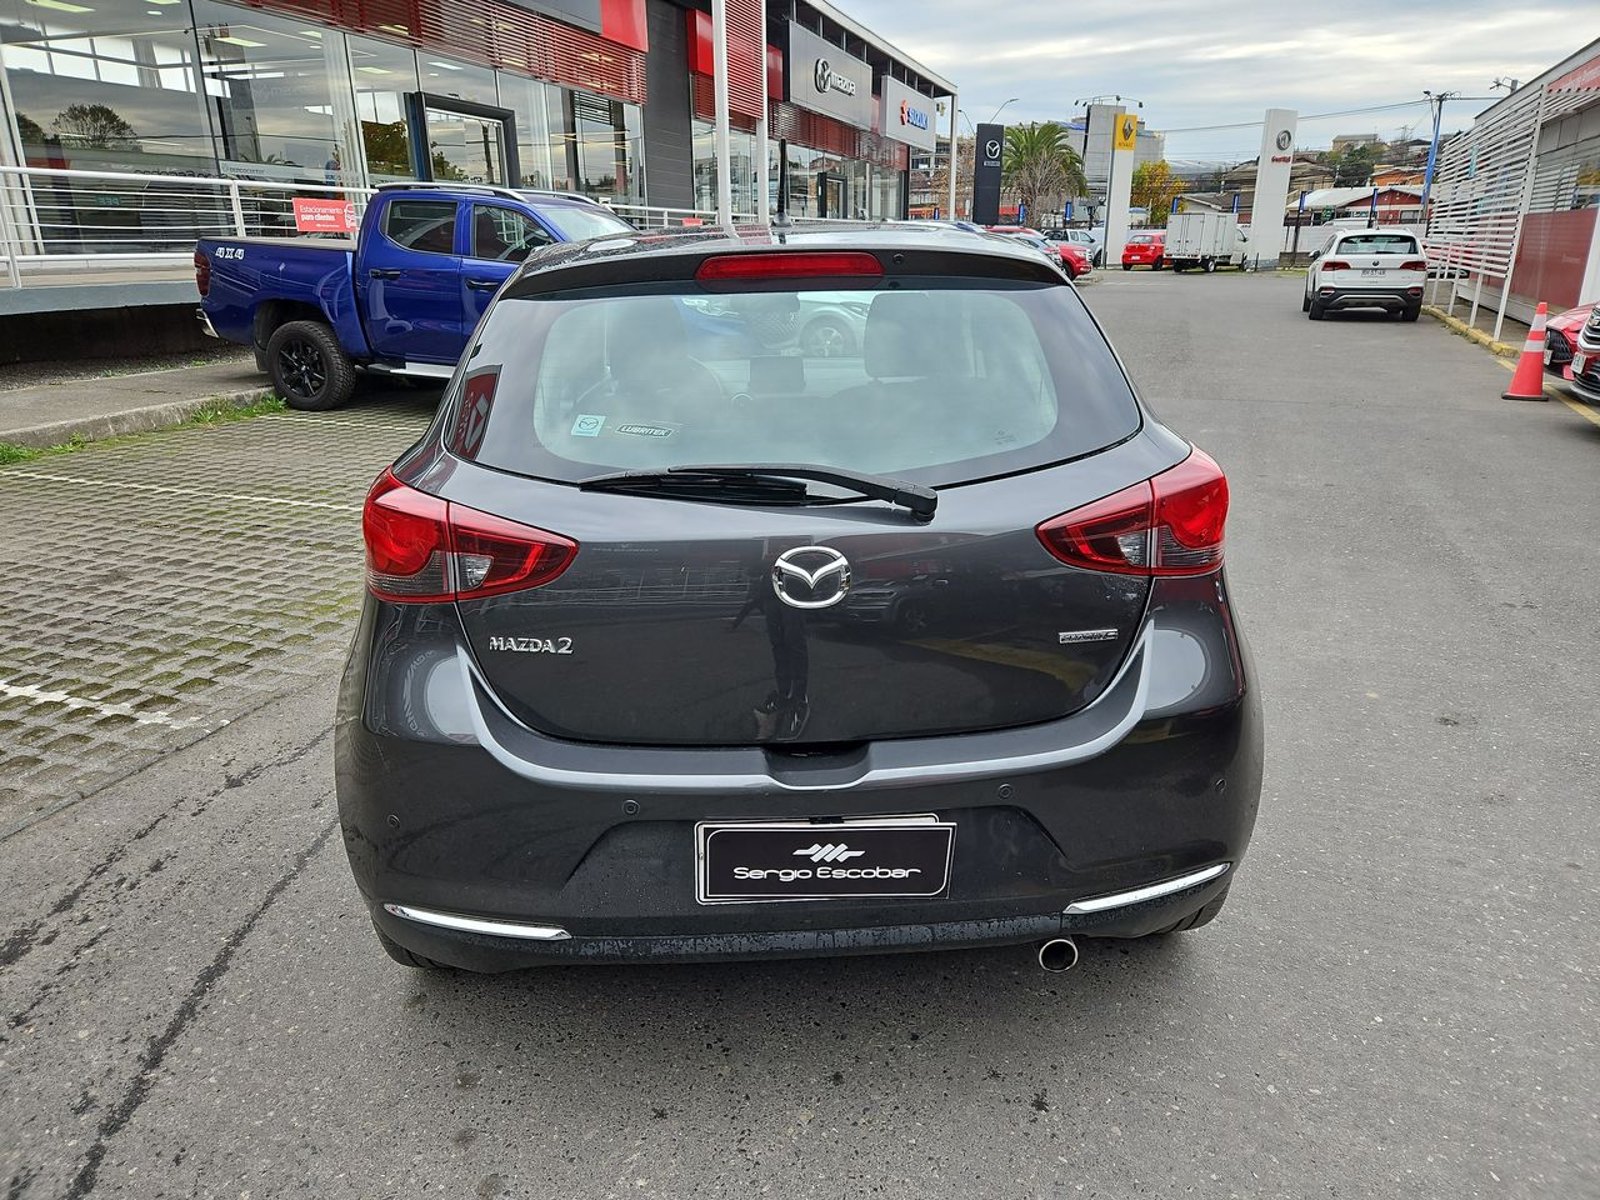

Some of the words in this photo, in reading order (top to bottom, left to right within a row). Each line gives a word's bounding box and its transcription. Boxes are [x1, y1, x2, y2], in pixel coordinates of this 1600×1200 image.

[300, 205, 343, 214] Estacionamento
[315, 213, 336, 221] clientes
[733, 866, 813, 882] Sergio
[816, 866, 922, 880] Escobar
